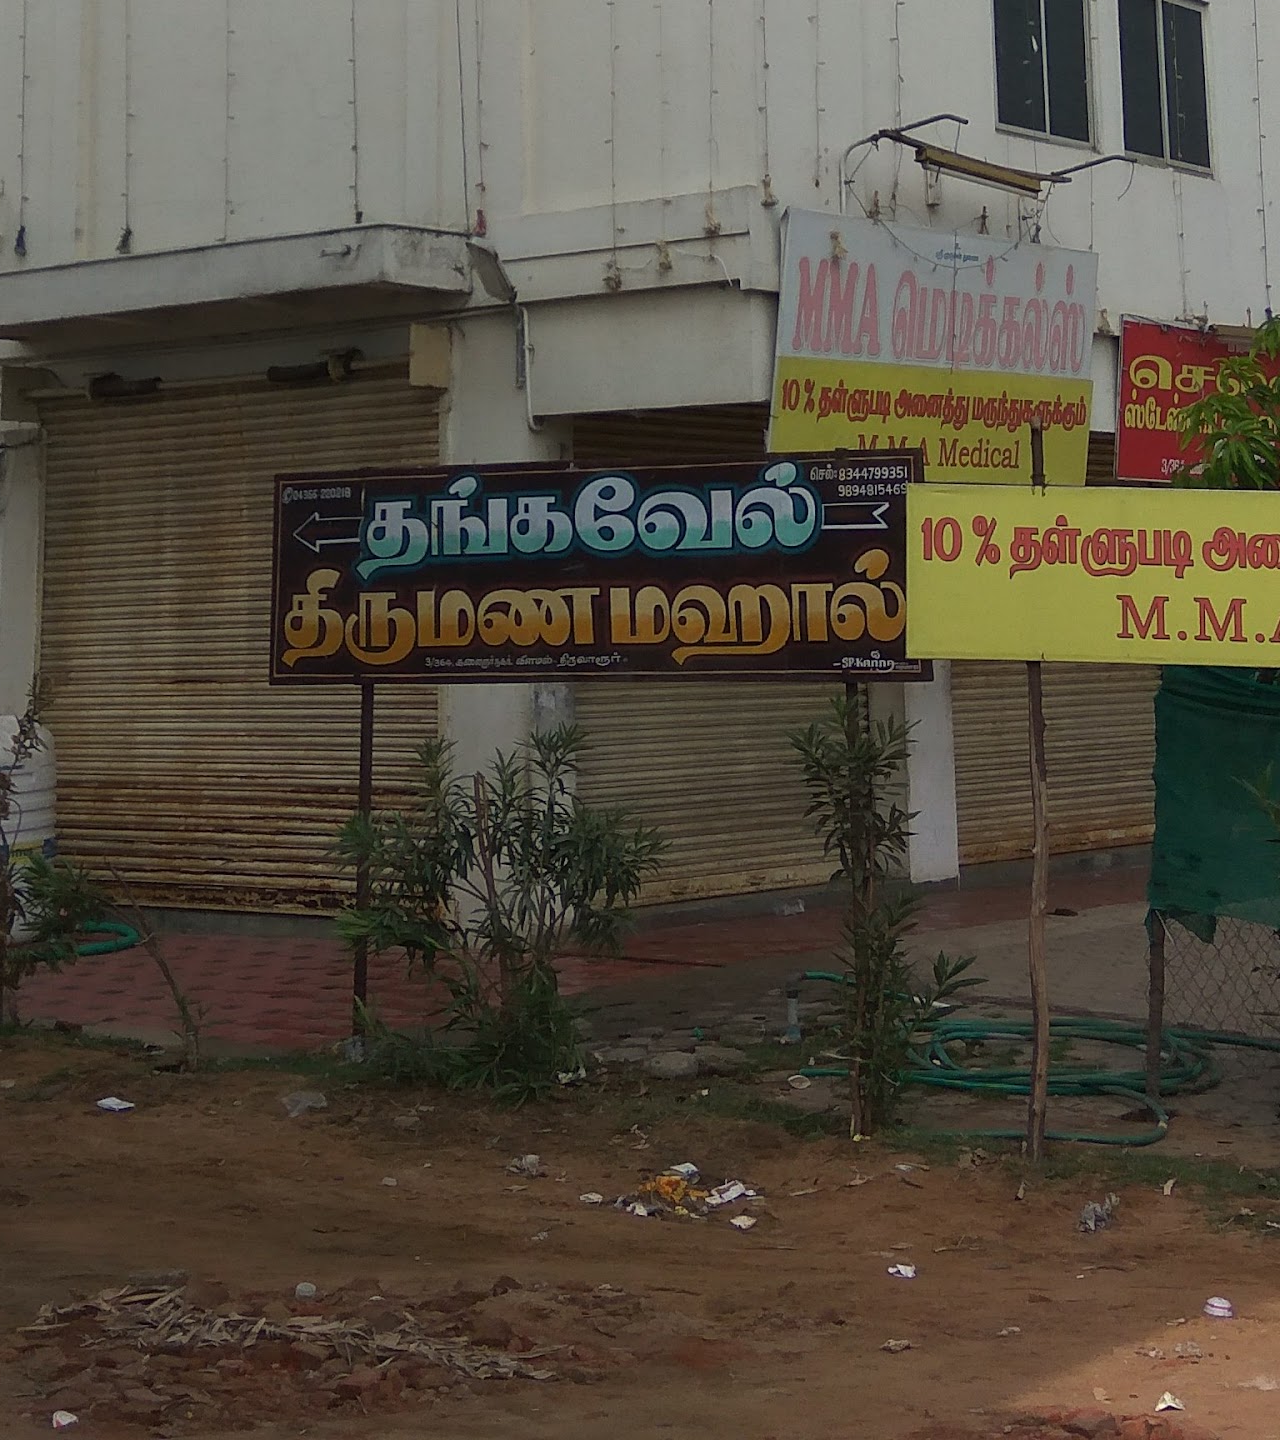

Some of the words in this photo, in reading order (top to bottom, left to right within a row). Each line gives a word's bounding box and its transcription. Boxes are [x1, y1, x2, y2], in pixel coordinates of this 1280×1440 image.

[792, 256, 880, 355] MMA
[892, 255, 1086, 373] மெடிக்கல்ஸ்
[782, 379, 800, 411] 10
[817, 379, 890, 423] தள்ளுபடி
[894, 387, 969, 430] அனைத்து
[937, 437, 1020, 468] Medical
[356, 462, 816, 579] தங்கவேல்
[921, 516, 963, 562] 10
[972, 515, 1000, 566] %
[1010, 515, 1194, 579] தள்ளுபடி
